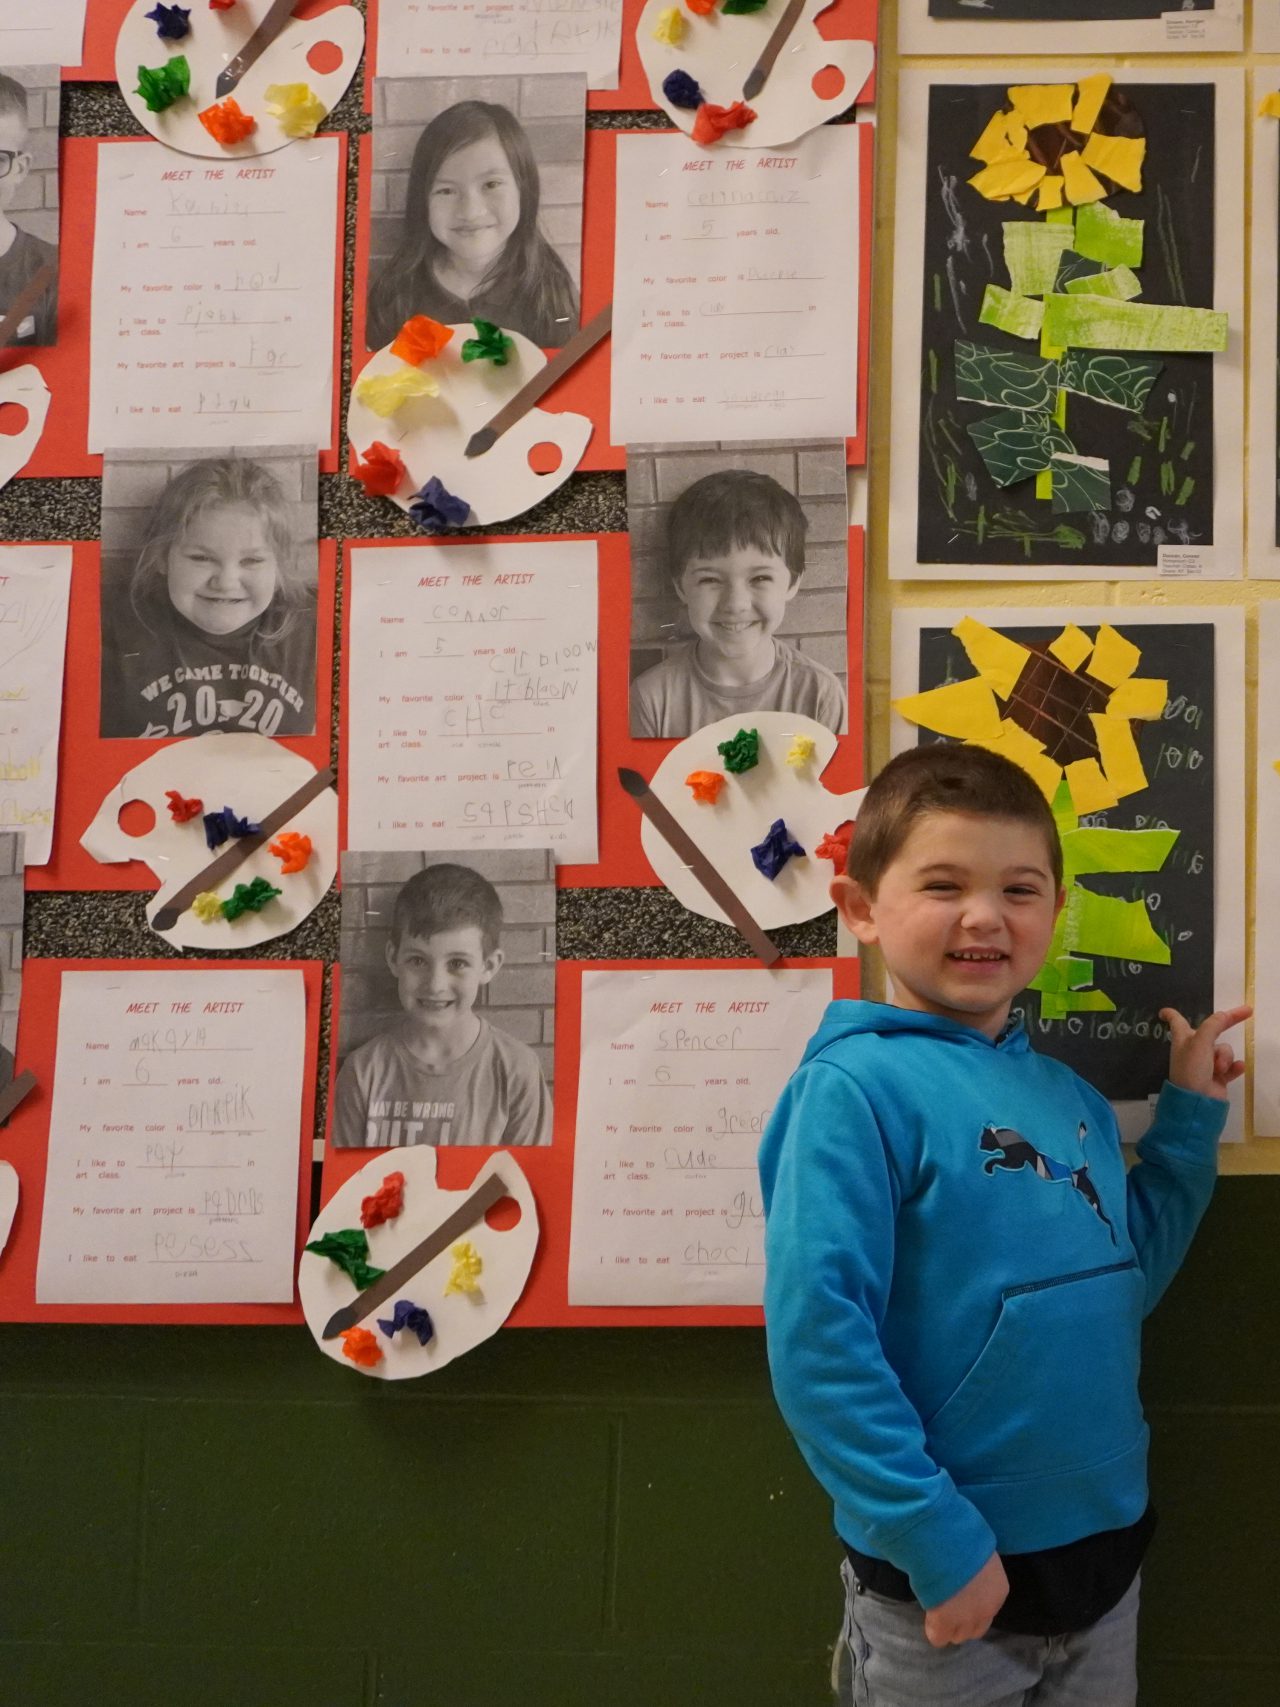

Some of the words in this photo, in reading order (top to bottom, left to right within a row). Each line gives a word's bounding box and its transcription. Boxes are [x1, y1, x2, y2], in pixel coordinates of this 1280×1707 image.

[682, 160, 715, 171] MEET
[726, 160, 745, 171] THE
[757, 158, 798, 168] ARTIST
[161, 170, 192, 181] MEET
[205, 169, 224, 180] THE
[236, 169, 276, 179] ARTIST
[643, 277, 654, 285] My
[666, 276, 697, 284] favorite
[121, 285, 131, 293] My
[184, 283, 203, 291] color
[641, 353, 652, 361] My
[720, 352, 748, 360] project
[418, 576, 450, 587] MEET
[463, 574, 483, 585] THE
[494, 573, 535, 584] ARTIST
[473, 647, 495, 657] years
[140, 675, 173, 702] WE
[175, 664, 223, 684] CAME
[379, 696, 390, 704] My
[378, 776, 389, 784] My
[398, 775, 429, 783] favorite
[458, 774, 487, 782] project
[393, 821, 407, 829] like
[126, 1002, 159, 1013] MEET
[171, 1002, 192, 1013] THE
[203, 1002, 244, 1013] ARTIST
[650, 1002, 683, 1013] MEET
[696, 1002, 716, 1013] THE
[728, 1002, 769, 1013] ARTIST
[611, 1042, 634, 1050] Name
[177, 1078, 199, 1086] years
[736, 1077, 750, 1085] old.
[412, 1102, 454, 1118] WRONG
[80, 1124, 91, 1133] My
[103, 1124, 134, 1132] favorite
[606, 1125, 618, 1133] My
[629, 1125, 662, 1133] favorite
[620, 1160, 634, 1168] like
[627, 1172, 650, 1180] class.
[73, 1207, 84, 1216] My
[153, 1208, 183, 1216] project
[623, 1208, 655, 1216] favorite
[661, 1208, 673, 1216] art
[686, 1208, 715, 1217] project
[616, 1256, 630, 1264] like
